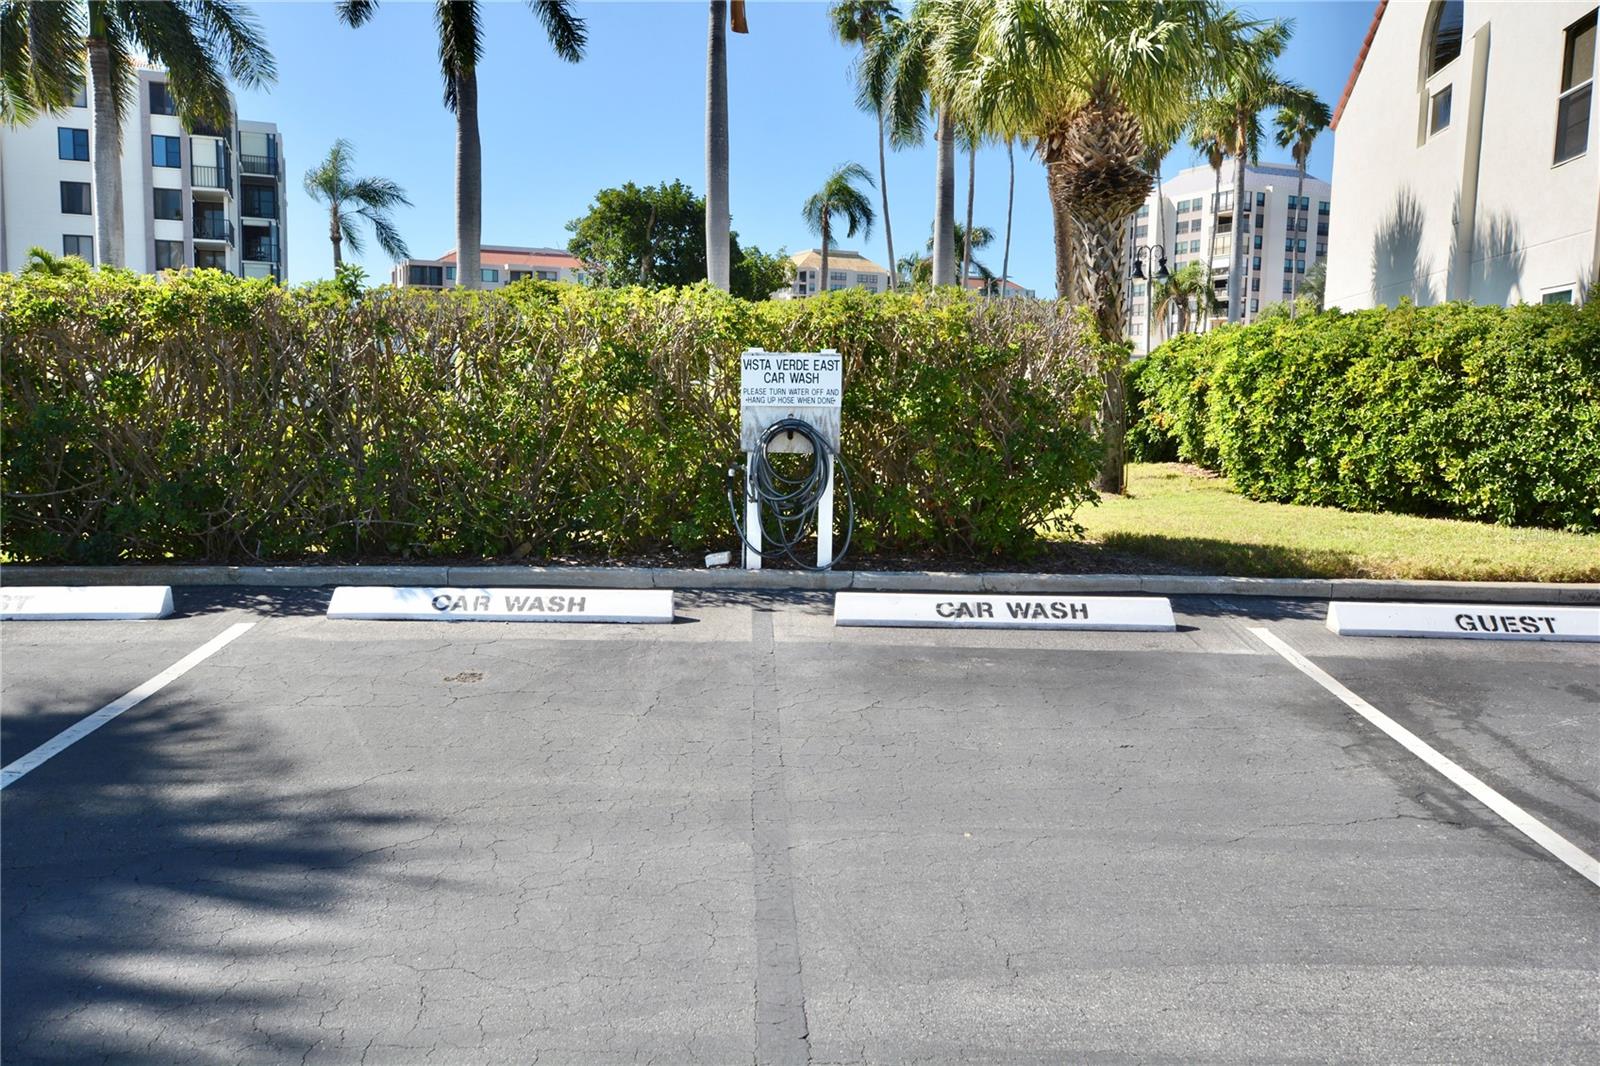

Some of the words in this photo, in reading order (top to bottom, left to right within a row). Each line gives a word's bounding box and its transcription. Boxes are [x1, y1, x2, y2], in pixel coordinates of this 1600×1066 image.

[743, 359, 771, 371] VISTA
[776, 359, 809, 371] VERDE
[814, 359, 840, 371] EAST
[764, 372, 785, 384] CAR
[790, 372, 819, 384] WASH
[743, 388, 766, 396] PLEASE
[770, 388, 786, 396] TURN
[789, 388, 809, 396] WATER
[797, 397, 816, 405] WHEN
[431, 594, 490, 612] CAR
[505, 596, 586, 613] WASH
[935, 601, 994, 619] CAR
[1006, 602, 1089, 620] WASH
[1454, 613, 1556, 634] GUEST
